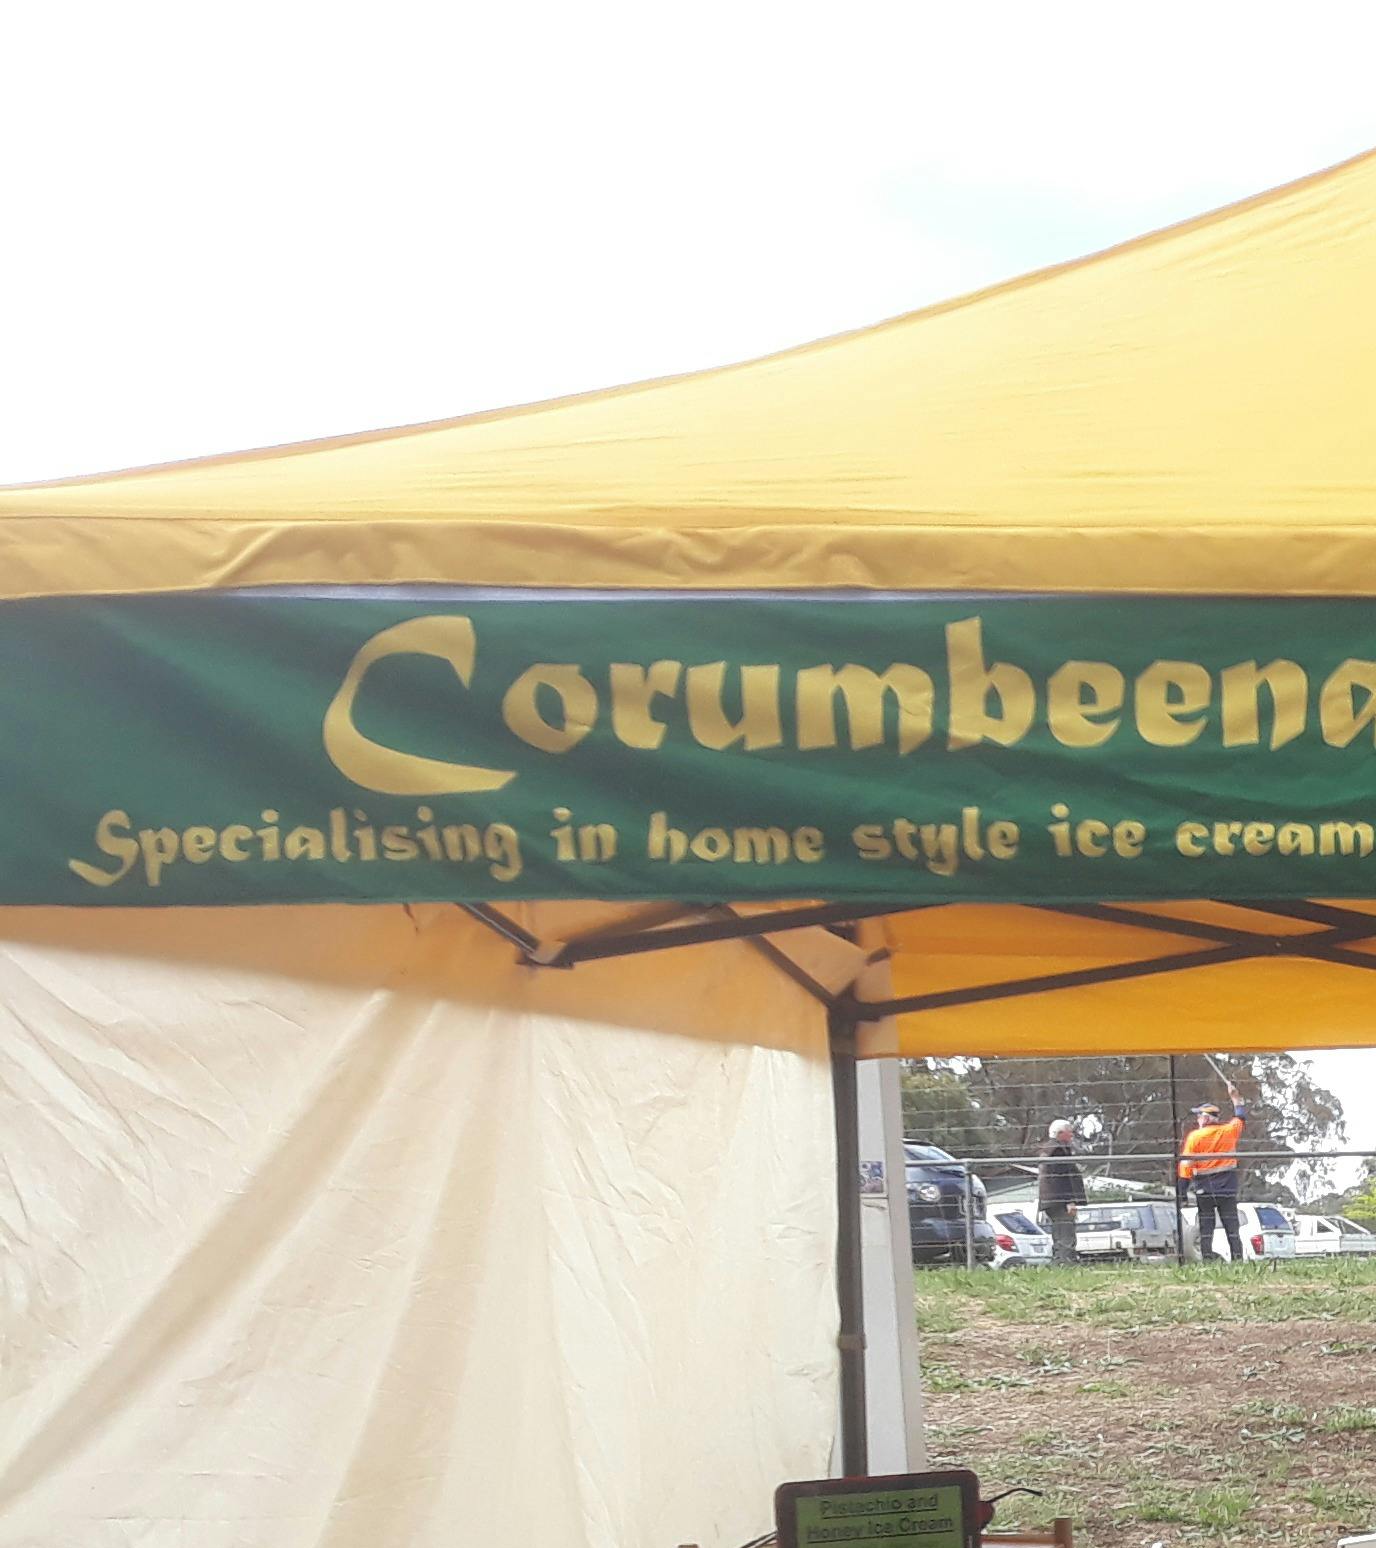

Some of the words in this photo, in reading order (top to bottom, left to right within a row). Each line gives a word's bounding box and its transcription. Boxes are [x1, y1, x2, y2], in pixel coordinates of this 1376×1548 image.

[68, 808, 523, 888] Specialising
[551, 807, 618, 862] in
[648, 810, 825, 865] home
[853, 806, 1020, 876] style
[1050, 803, 1144, 858] ice
